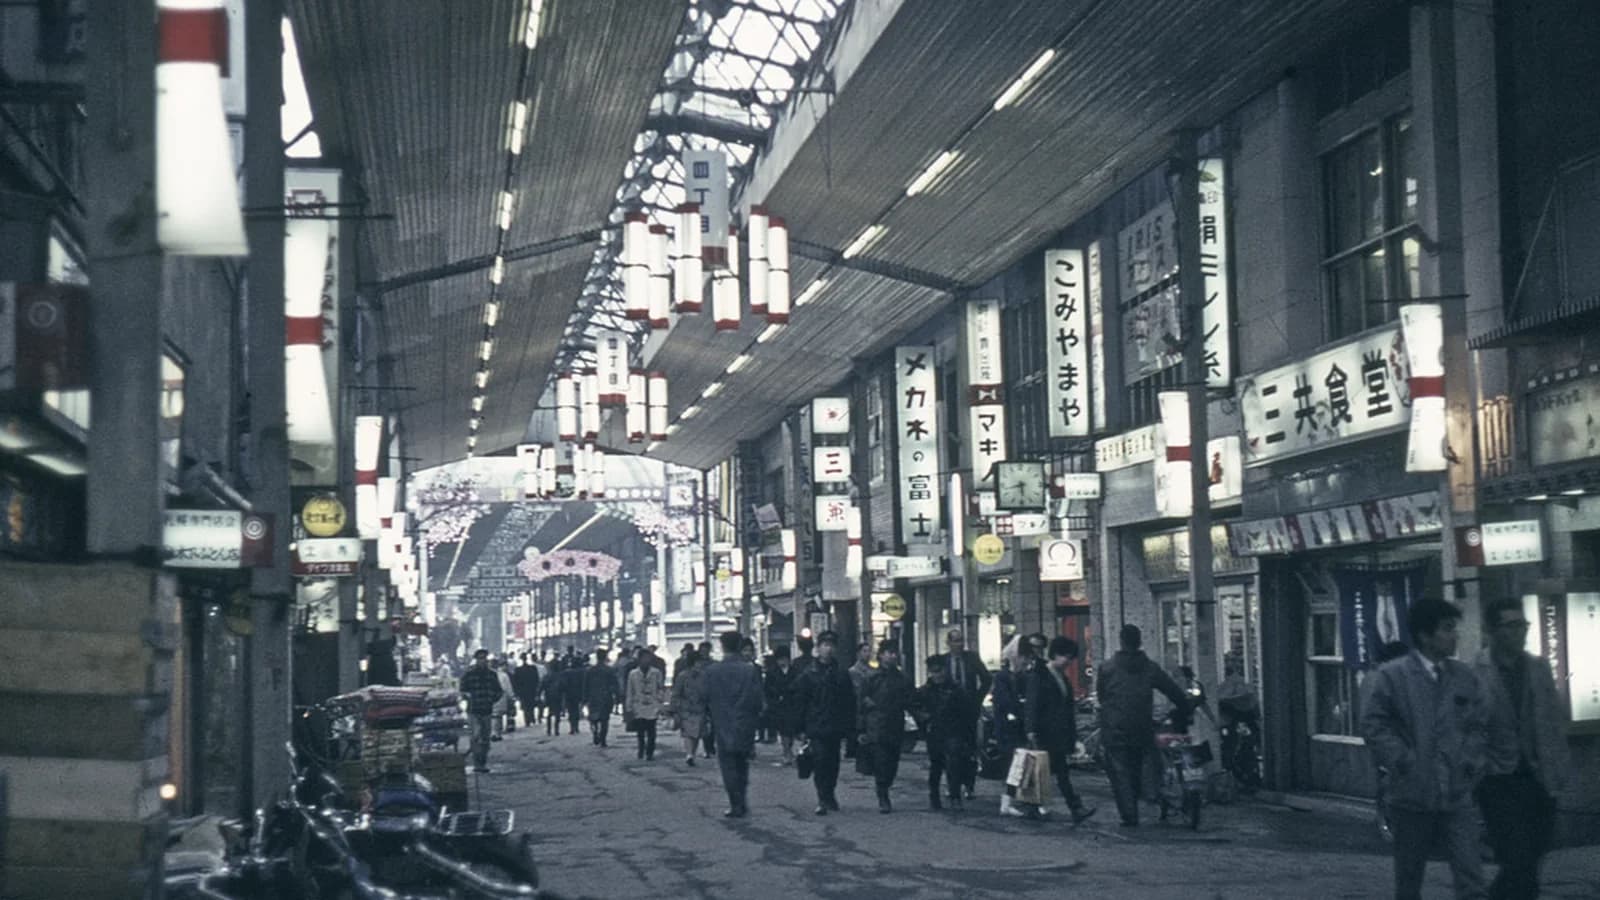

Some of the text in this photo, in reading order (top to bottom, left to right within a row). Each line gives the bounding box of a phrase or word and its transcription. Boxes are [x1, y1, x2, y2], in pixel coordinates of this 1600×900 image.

[1053, 258, 1081, 426] こみやまや
[1261, 347, 1393, 445] 三共食堂
